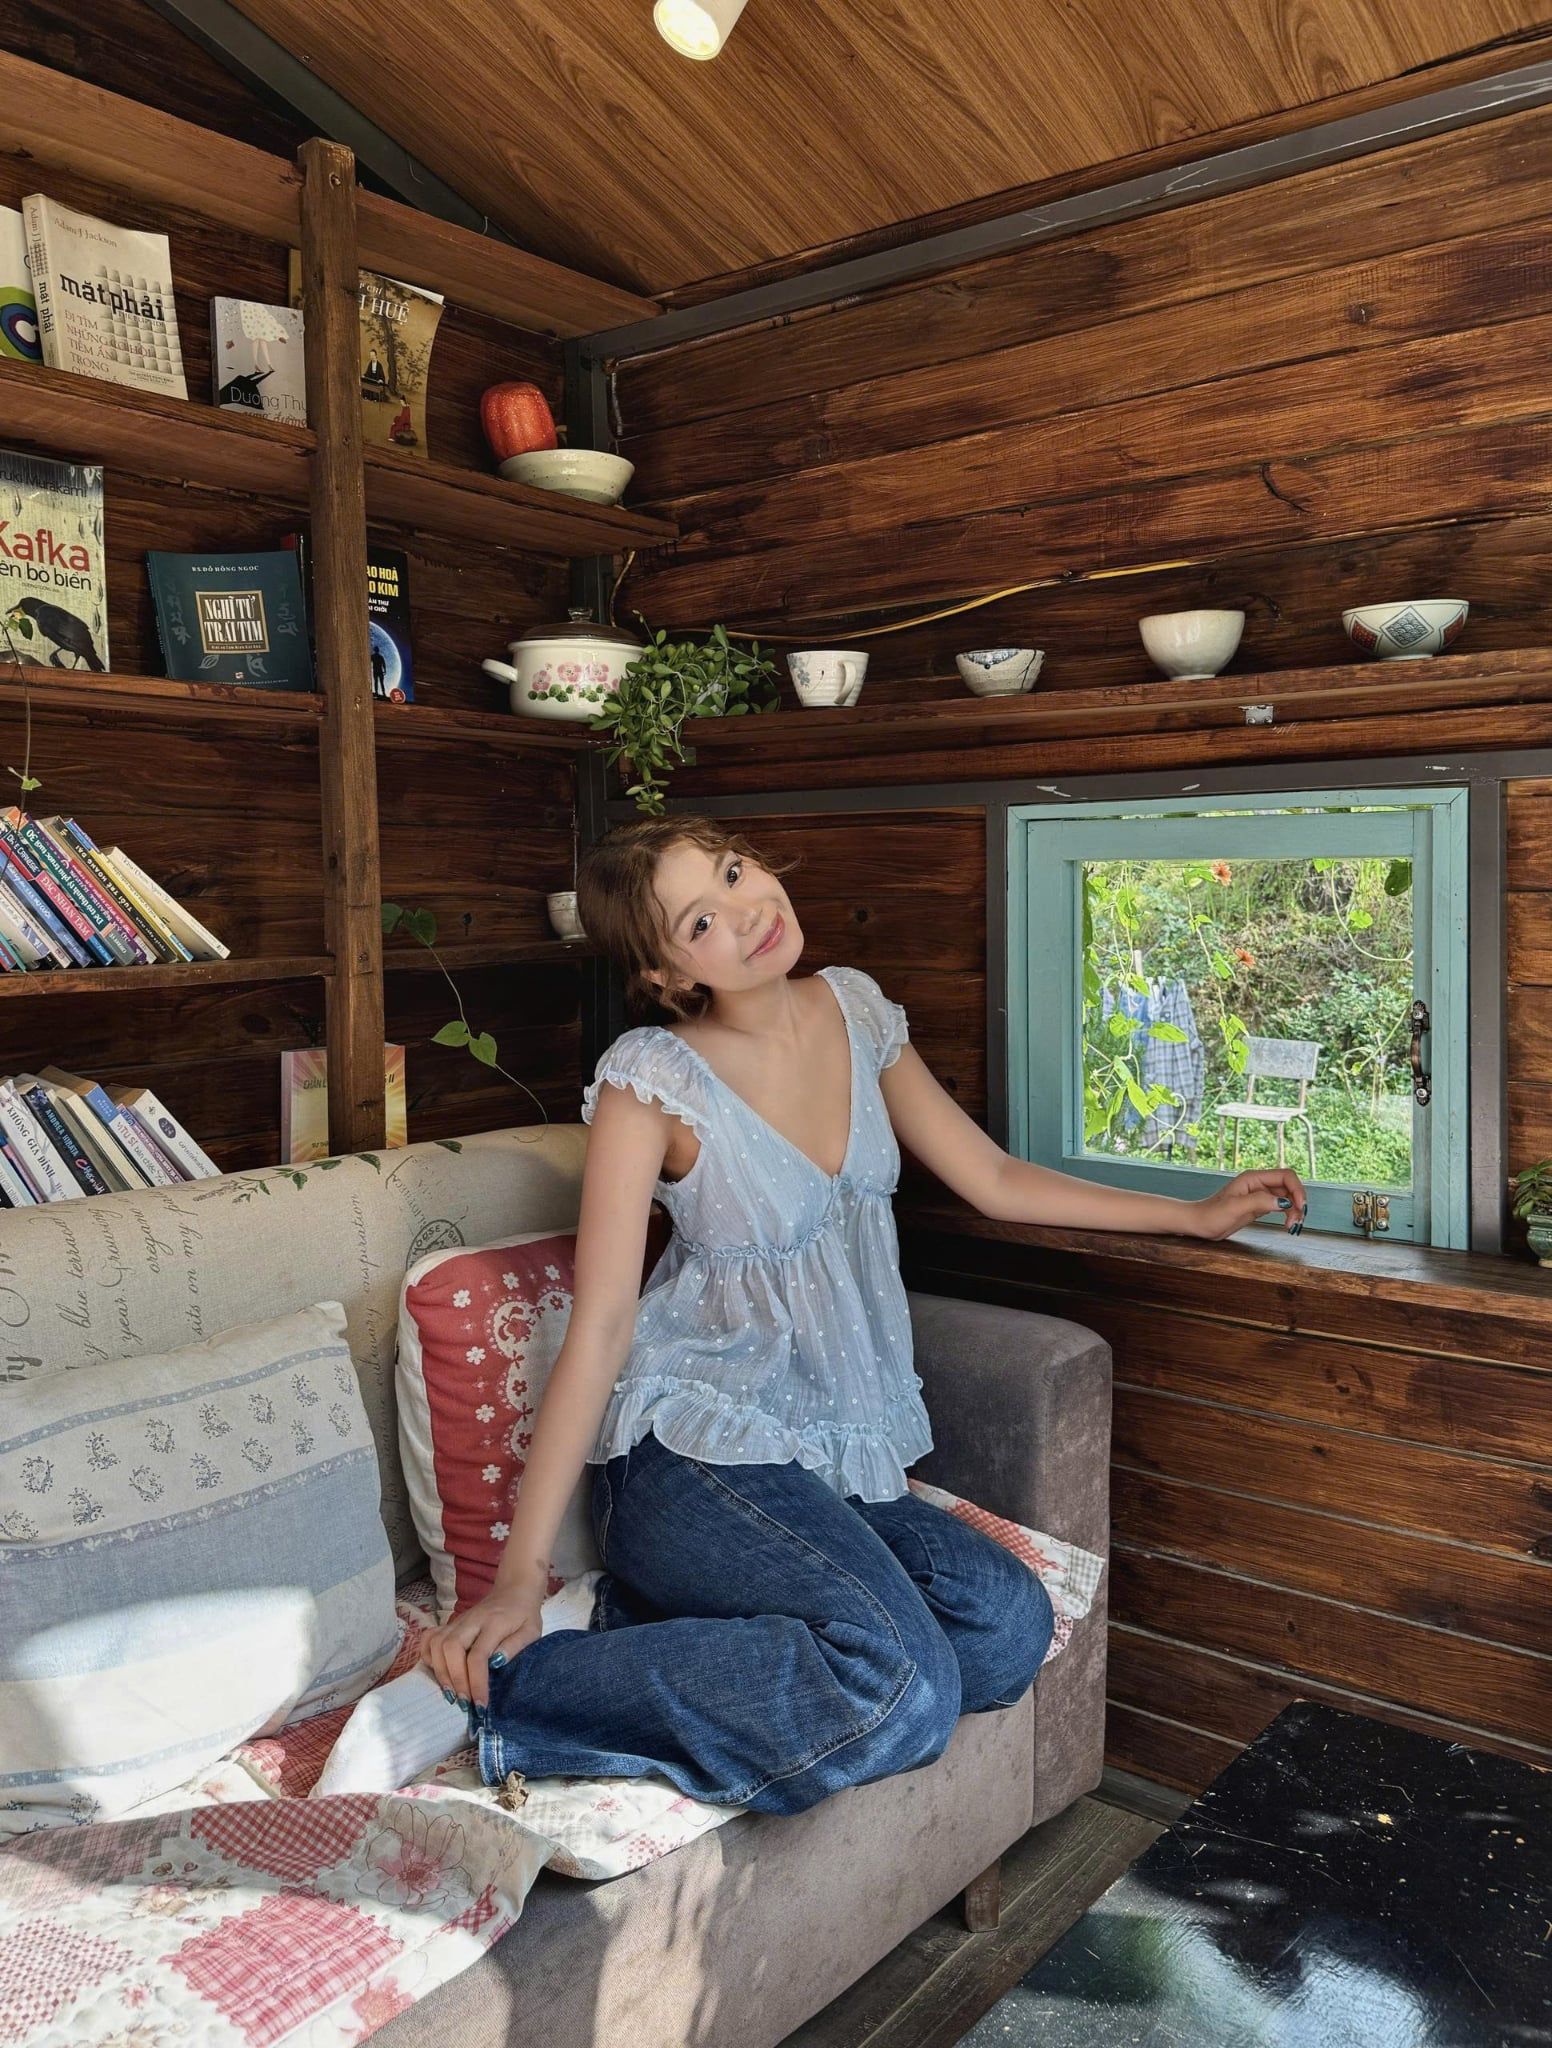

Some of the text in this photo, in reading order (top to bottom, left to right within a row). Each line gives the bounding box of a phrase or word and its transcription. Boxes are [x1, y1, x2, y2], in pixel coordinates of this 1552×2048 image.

[26, 474, 87, 498] Murakami
[378, 582, 399, 598] KIM
[204, 596, 236, 620] NGHĨ
[236, 620, 264, 642] TIM
[26, 829, 38, 842] 30
[87, 859, 107, 884] HOANG
[55, 896, 76, 920] NHÂN
[6, 1106, 30, 1138] KHÔNG
[26, 1138, 40, 1156] GIA
[45, 1109, 80, 1156] ANDREA HIRATA
[178, 1222, 204, 1258] my
[351, 1192, 382, 1294] inspiration
[188, 1268, 200, 1295] on
[56, 1291, 92, 1329] blue
[184, 1304, 203, 1336] sits
